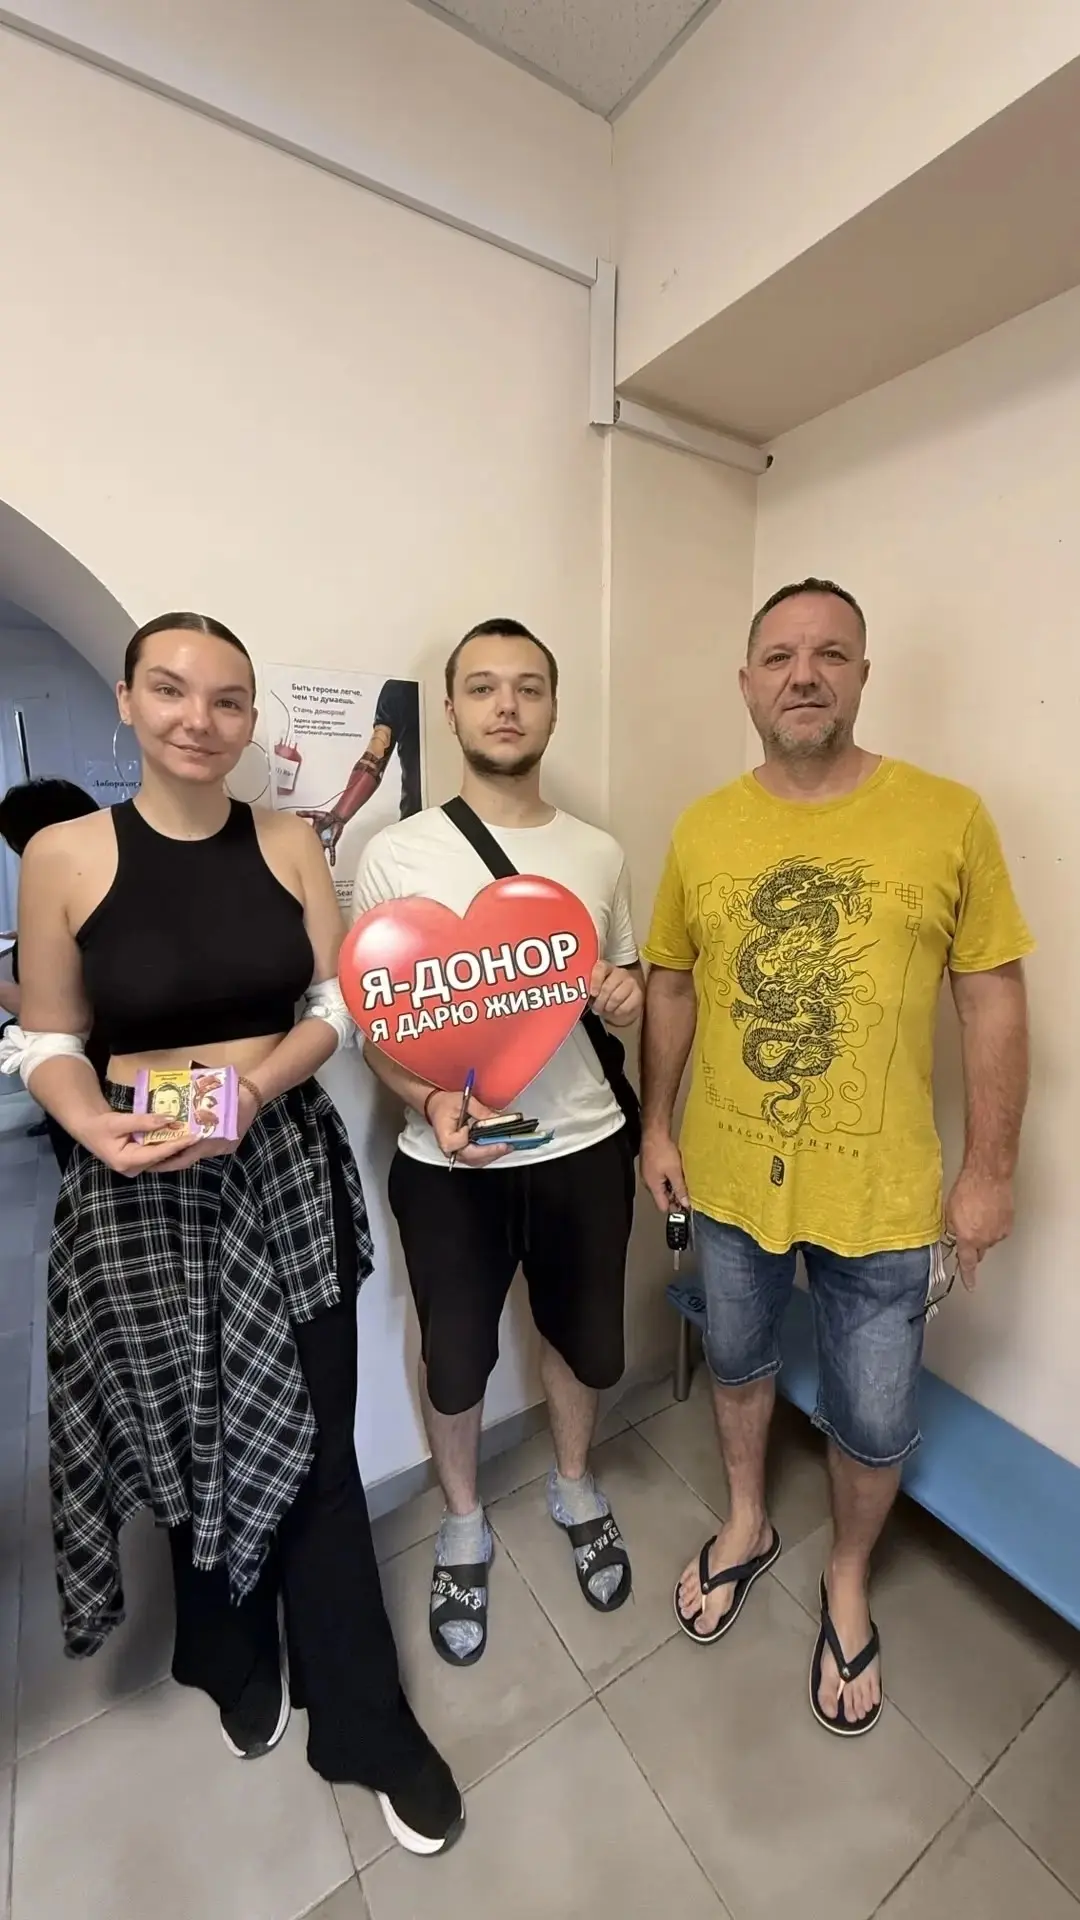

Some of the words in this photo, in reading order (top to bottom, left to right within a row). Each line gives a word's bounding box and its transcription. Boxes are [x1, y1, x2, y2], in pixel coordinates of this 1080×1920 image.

[292, 683, 311, 692] Быть
[312, 686, 339, 694] героем
[293, 706, 313, 714] Стань
[361, 932, 579, 1010] Я-ДОНОР
[370, 1018, 390, 1043] Я
[395, 1001, 479, 1043] ДАРЮ
[483, 976, 589, 1020] ЖИЗНЬ!
